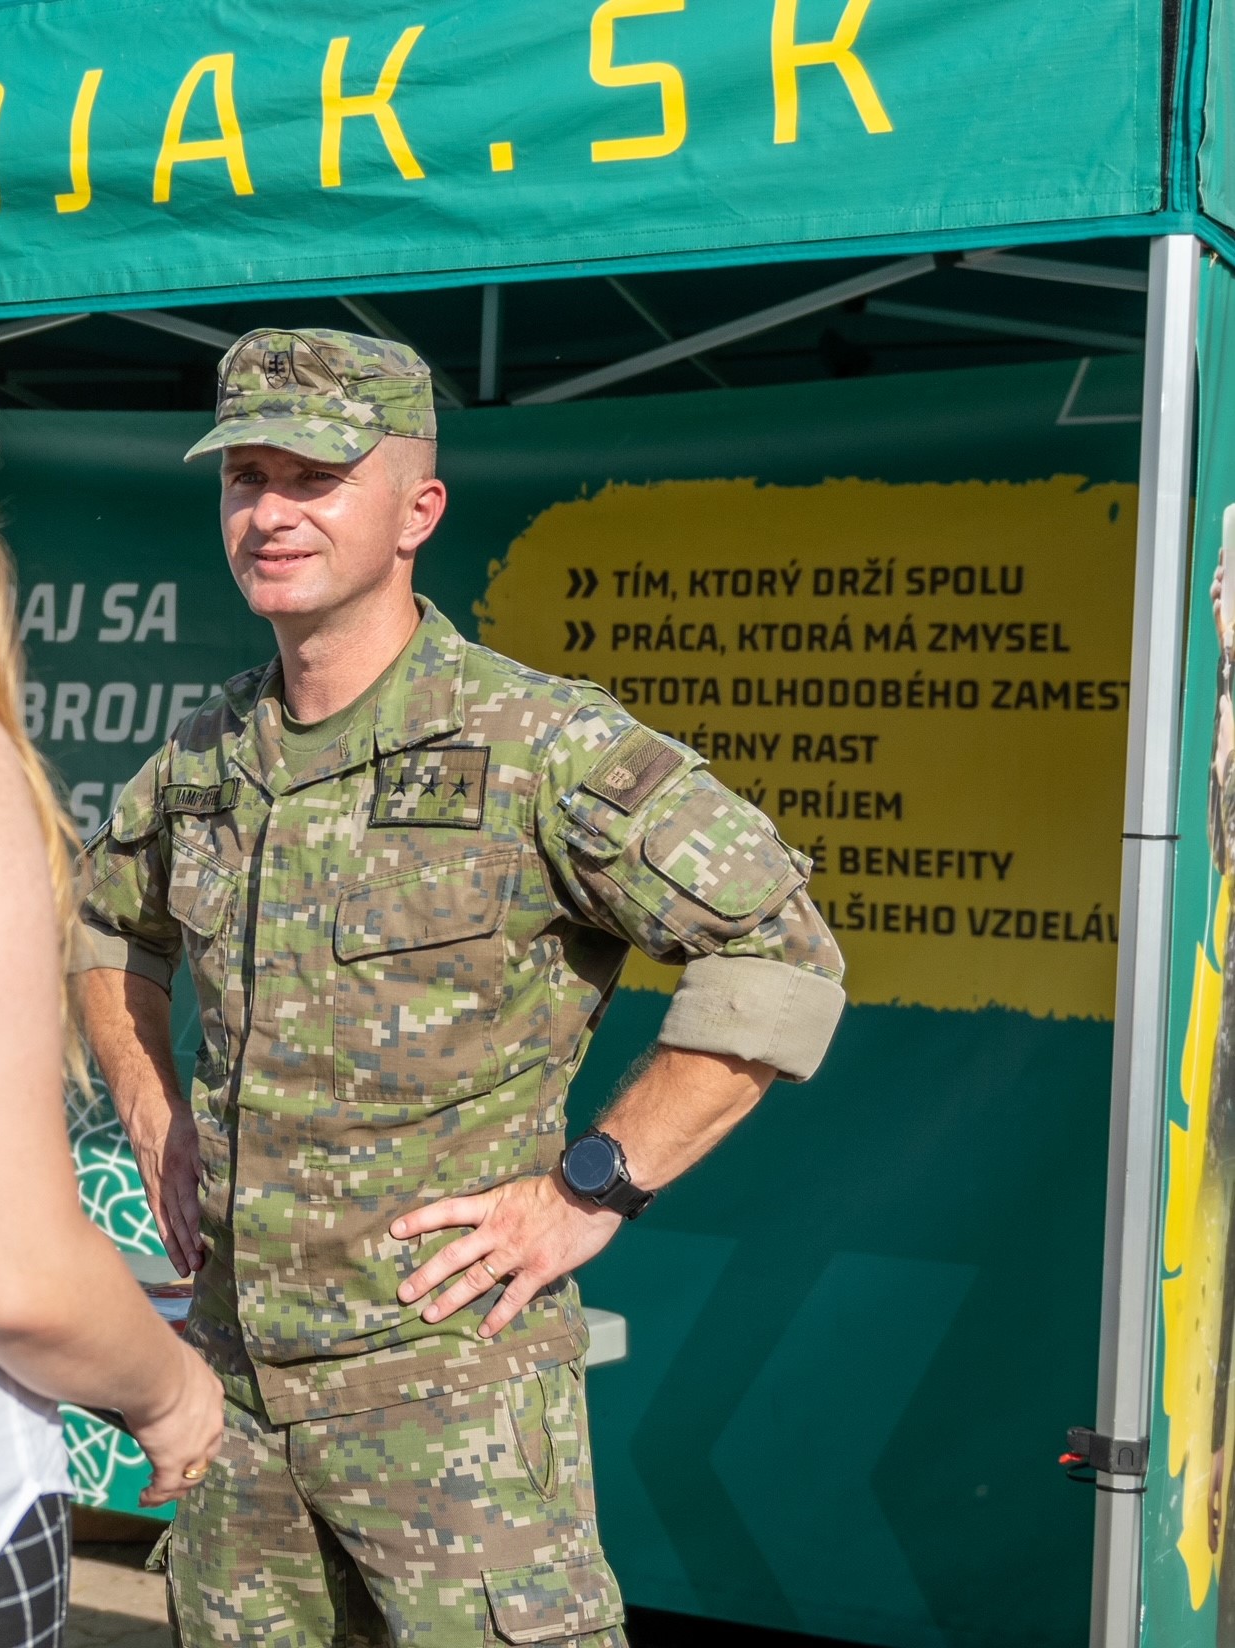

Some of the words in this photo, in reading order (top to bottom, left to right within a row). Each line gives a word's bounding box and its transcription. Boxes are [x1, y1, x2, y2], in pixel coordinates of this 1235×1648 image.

[612, 561, 678, 601] TÍM,
[688, 559, 802, 598] KTORÝ
[812, 557, 896, 597] DRŽÍ
[906, 565, 1024, 597] SPOLU
[98, 582, 178, 644] SA
[611, 614, 726, 656] PRÁCA,
[738, 613, 854, 652] KTORÁ
[864, 613, 917, 653] MÁ
[927, 622, 1071, 654] ZMYSEL
[610, 676, 721, 706] ISTOTA
[731, 670, 980, 709] DLHODOBÉHO
[792, 733, 879, 763] RAST
[777, 780, 903, 821] PRÍJEM
[838, 845, 1014, 881] BENEFITY
[815, 893, 957, 936] LŠIEHO
